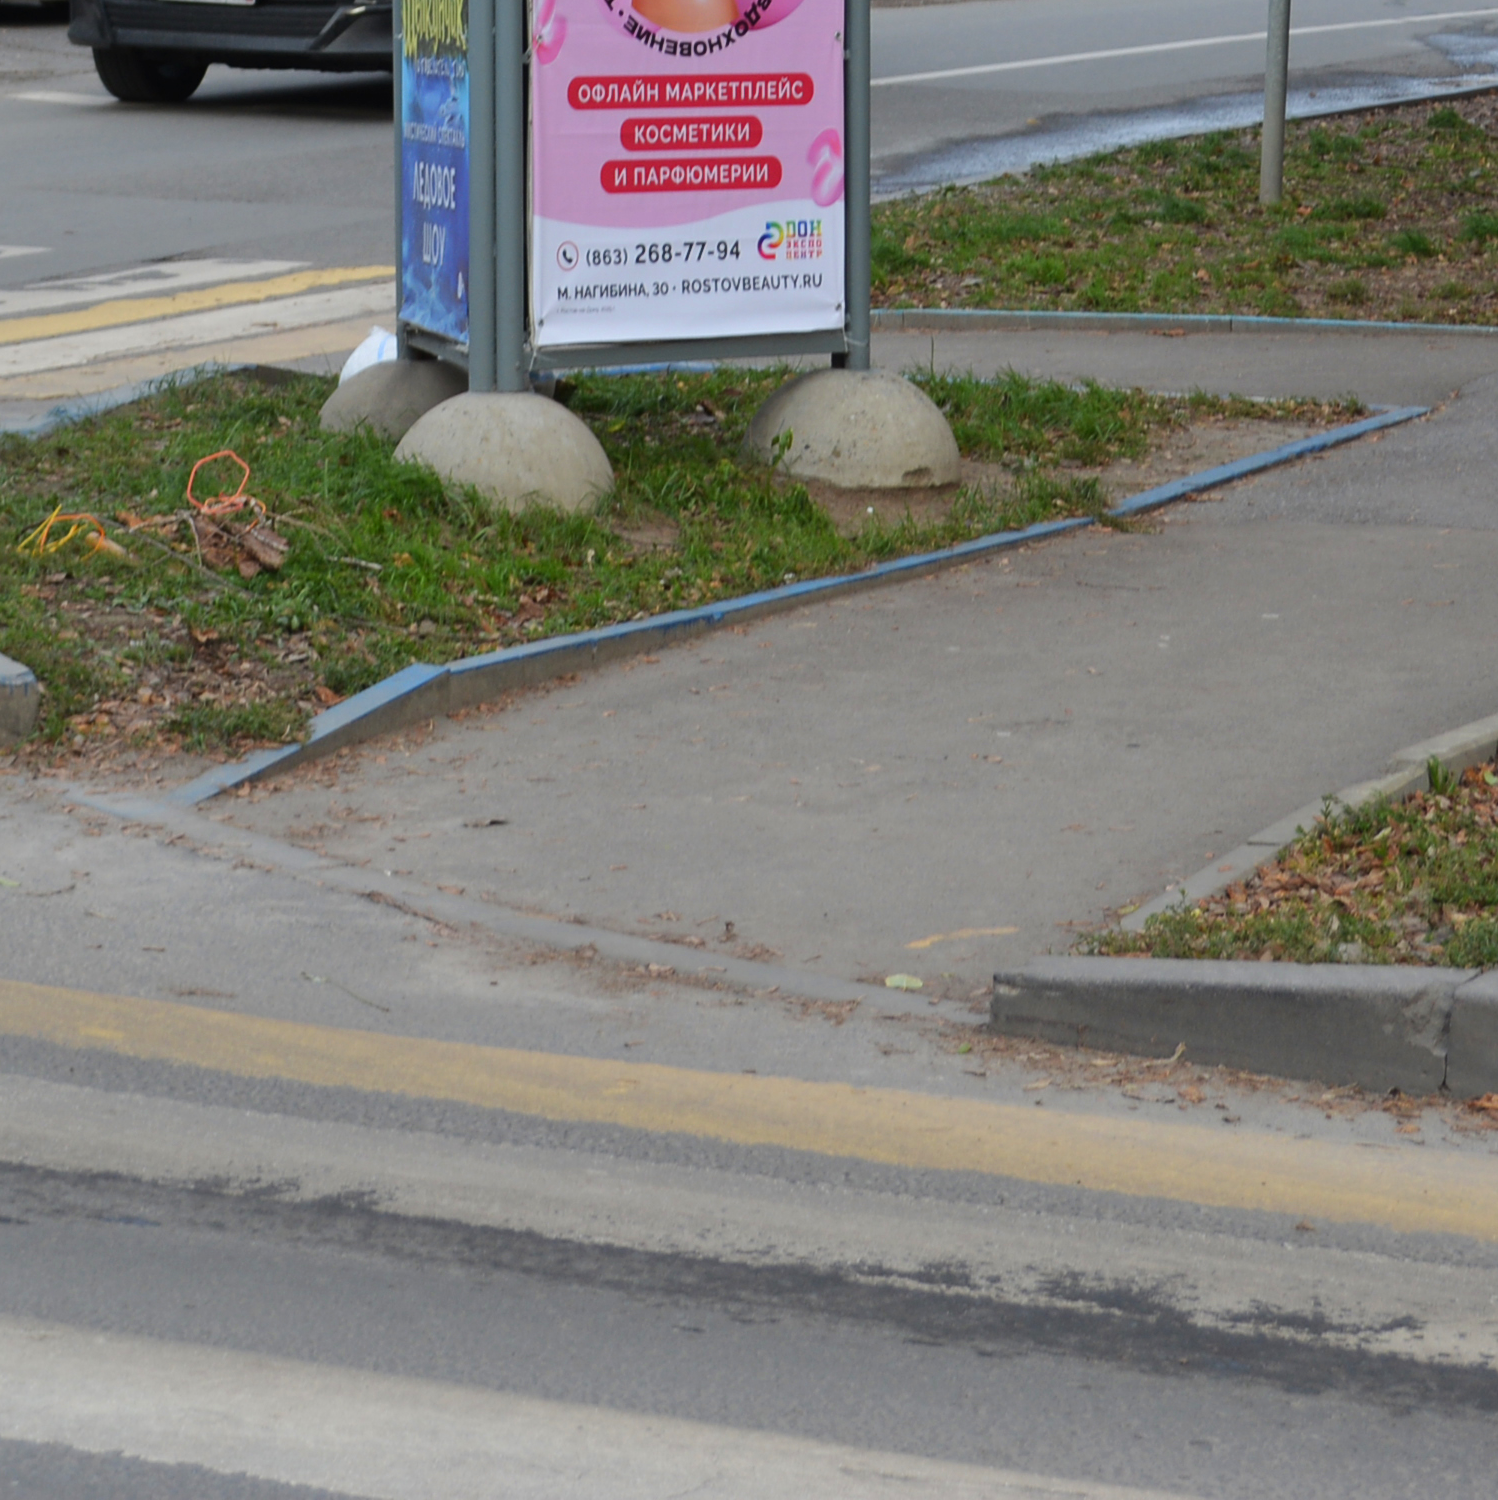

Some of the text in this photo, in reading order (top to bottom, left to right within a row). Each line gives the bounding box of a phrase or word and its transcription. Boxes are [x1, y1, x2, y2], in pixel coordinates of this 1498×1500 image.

[577, 77, 804, 103] ОФЛАЙН МАРКЕТПЛЕЙС
[634, 122, 750, 144] КОСМЕТИКИ
[412, 160, 456, 210] ЛЕДОВОЕ
[614, 163, 769, 187] И ПАРФЮМЕРИИ
[422, 221, 446, 266] ШОУ
[585, 240, 741, 267] (863) 268-77-94
[557, 280, 669, 301] М. НАГИБИНА, 30
[681, 273, 823, 295] ROSTOVBEAUTY.RU
